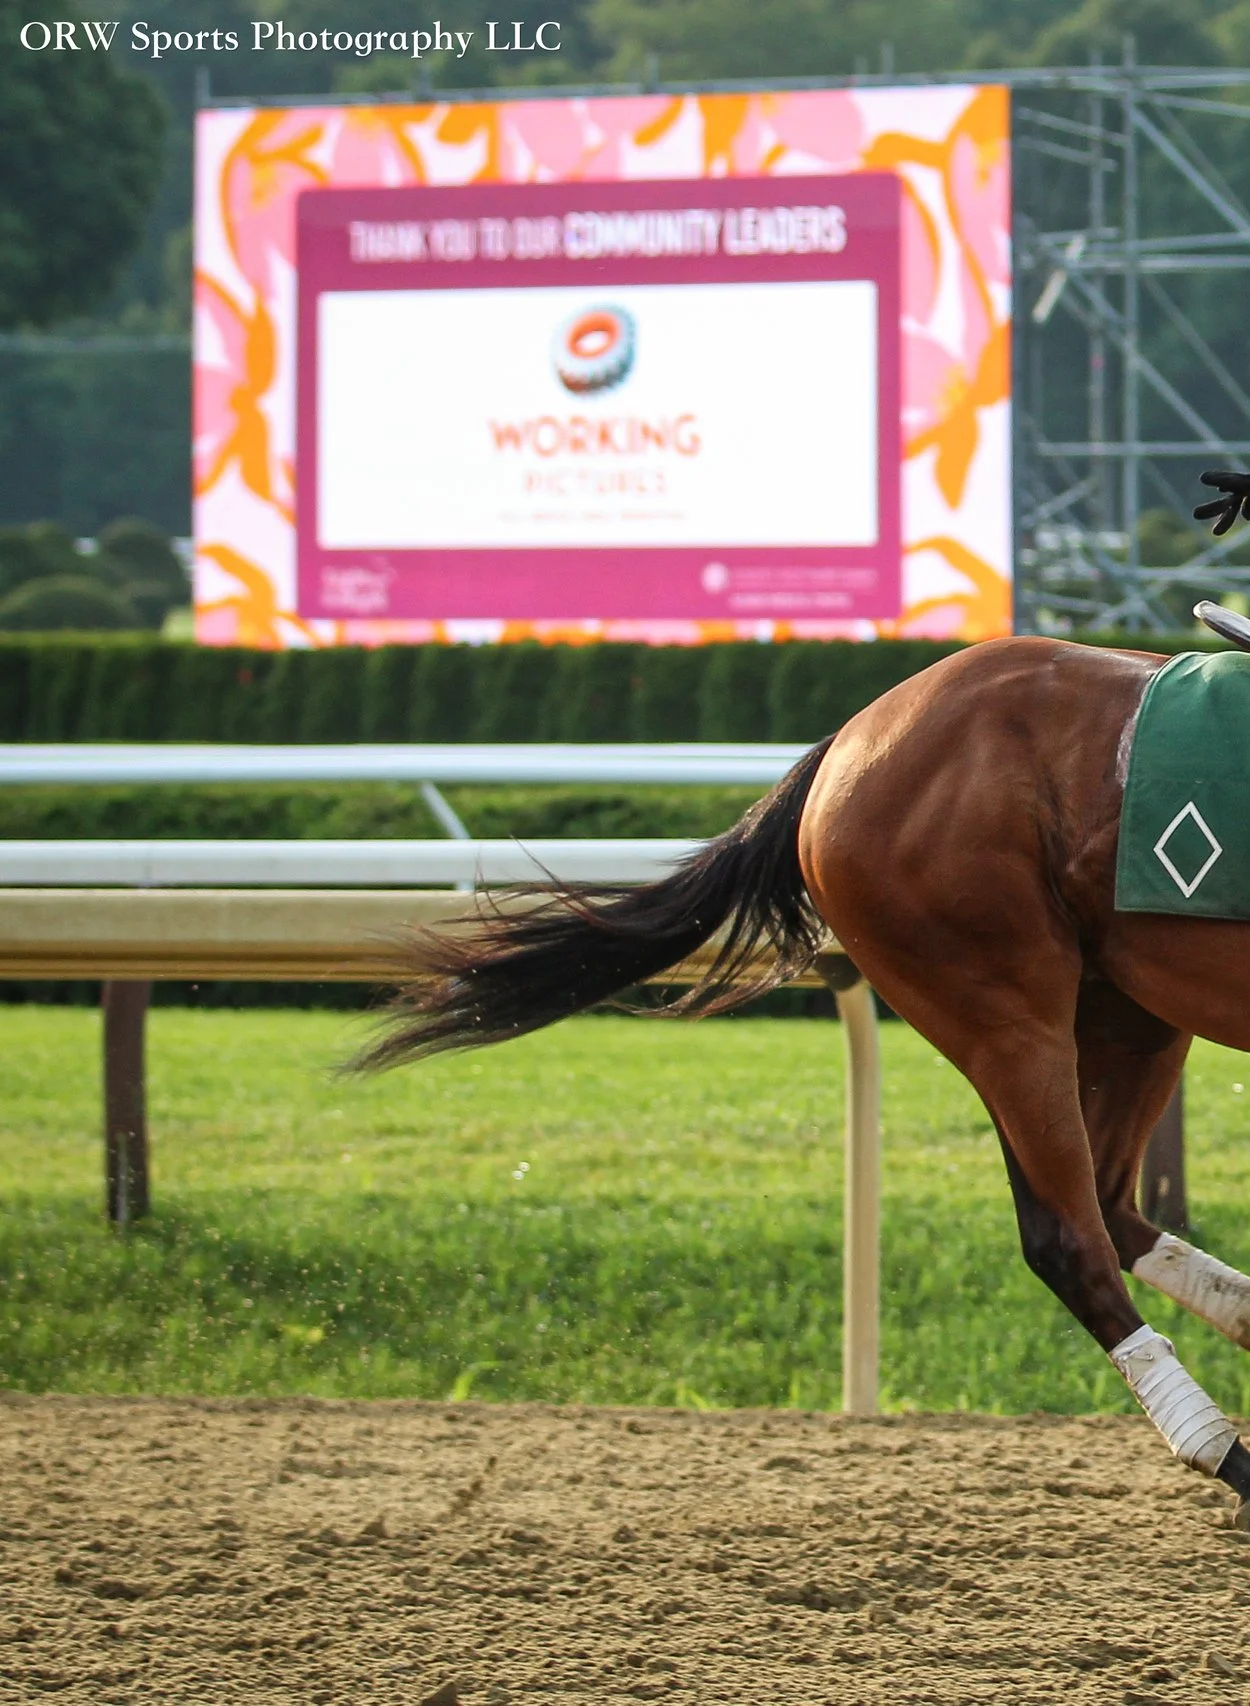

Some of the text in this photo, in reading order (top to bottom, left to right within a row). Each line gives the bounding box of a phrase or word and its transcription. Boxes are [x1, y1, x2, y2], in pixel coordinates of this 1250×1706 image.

[349, 204, 848, 263] THANK YOU TO OUR COMMUNITY LEADERS
[489, 413, 702, 458] WORKING
